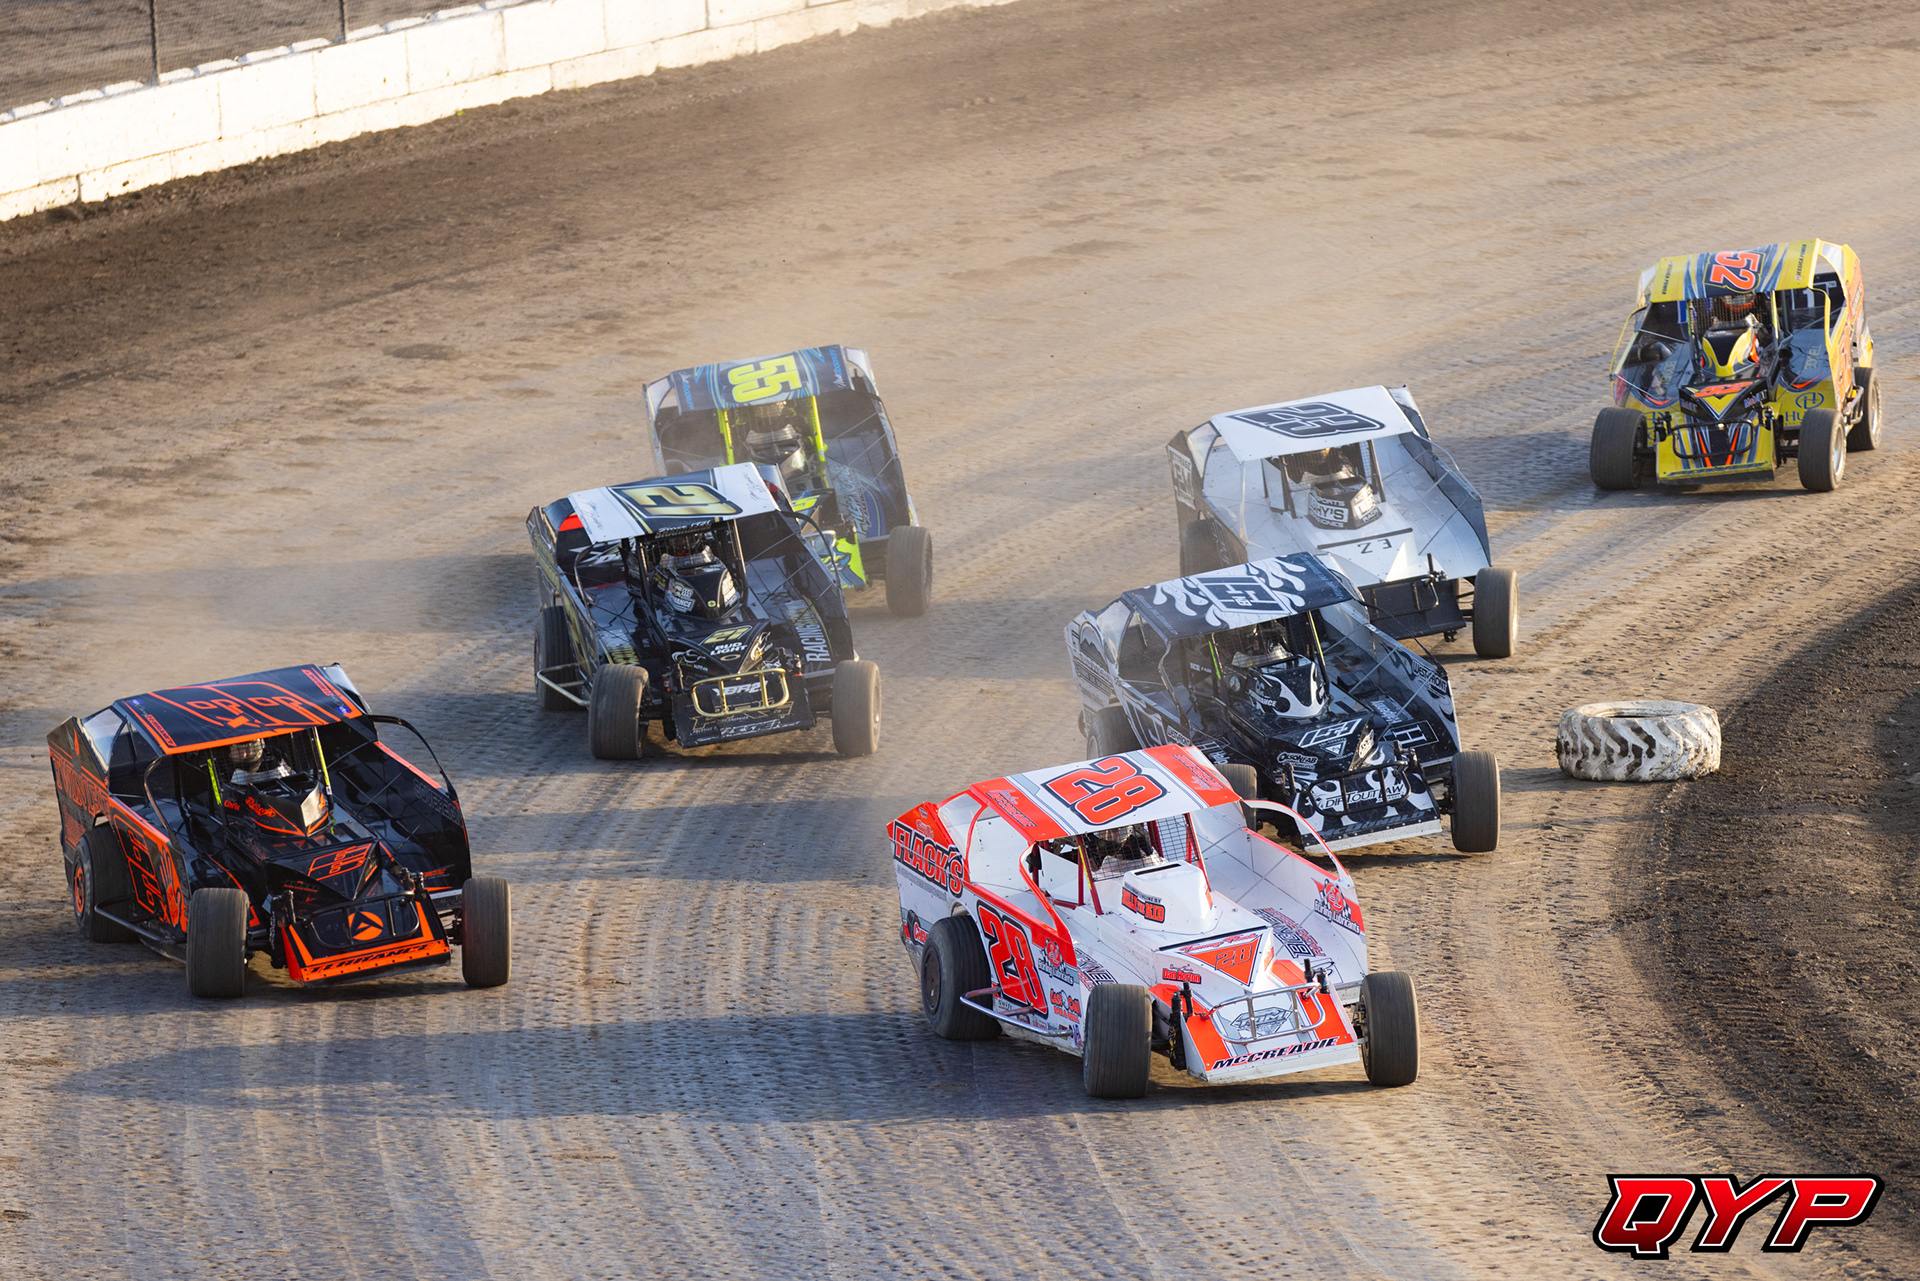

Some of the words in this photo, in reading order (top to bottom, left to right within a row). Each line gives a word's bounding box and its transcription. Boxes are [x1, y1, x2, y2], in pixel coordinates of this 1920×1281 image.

[1705, 249, 1766, 294] 52
[727, 355, 802, 403] 55
[1226, 400, 1386, 438] 23
[610, 483, 743, 518] 21
[703, 625, 753, 645] 21
[710, 644, 748, 657] LIGHT
[714, 641, 742, 652] BUD
[797, 620, 832, 663] RACING
[224, 800, 240, 811] Chris
[1041, 755, 1168, 826] 28
[893, 820, 964, 899] FLACK'S
[1145, 901, 1166, 924] KID
[977, 900, 1049, 1020] 28
[1215, 944, 1254, 970] 28
[1163, 968, 1177, 982] Dan
[1177, 969, 1202, 985] Horton
[1212, 1035, 1341, 1070] MCCREADIE
